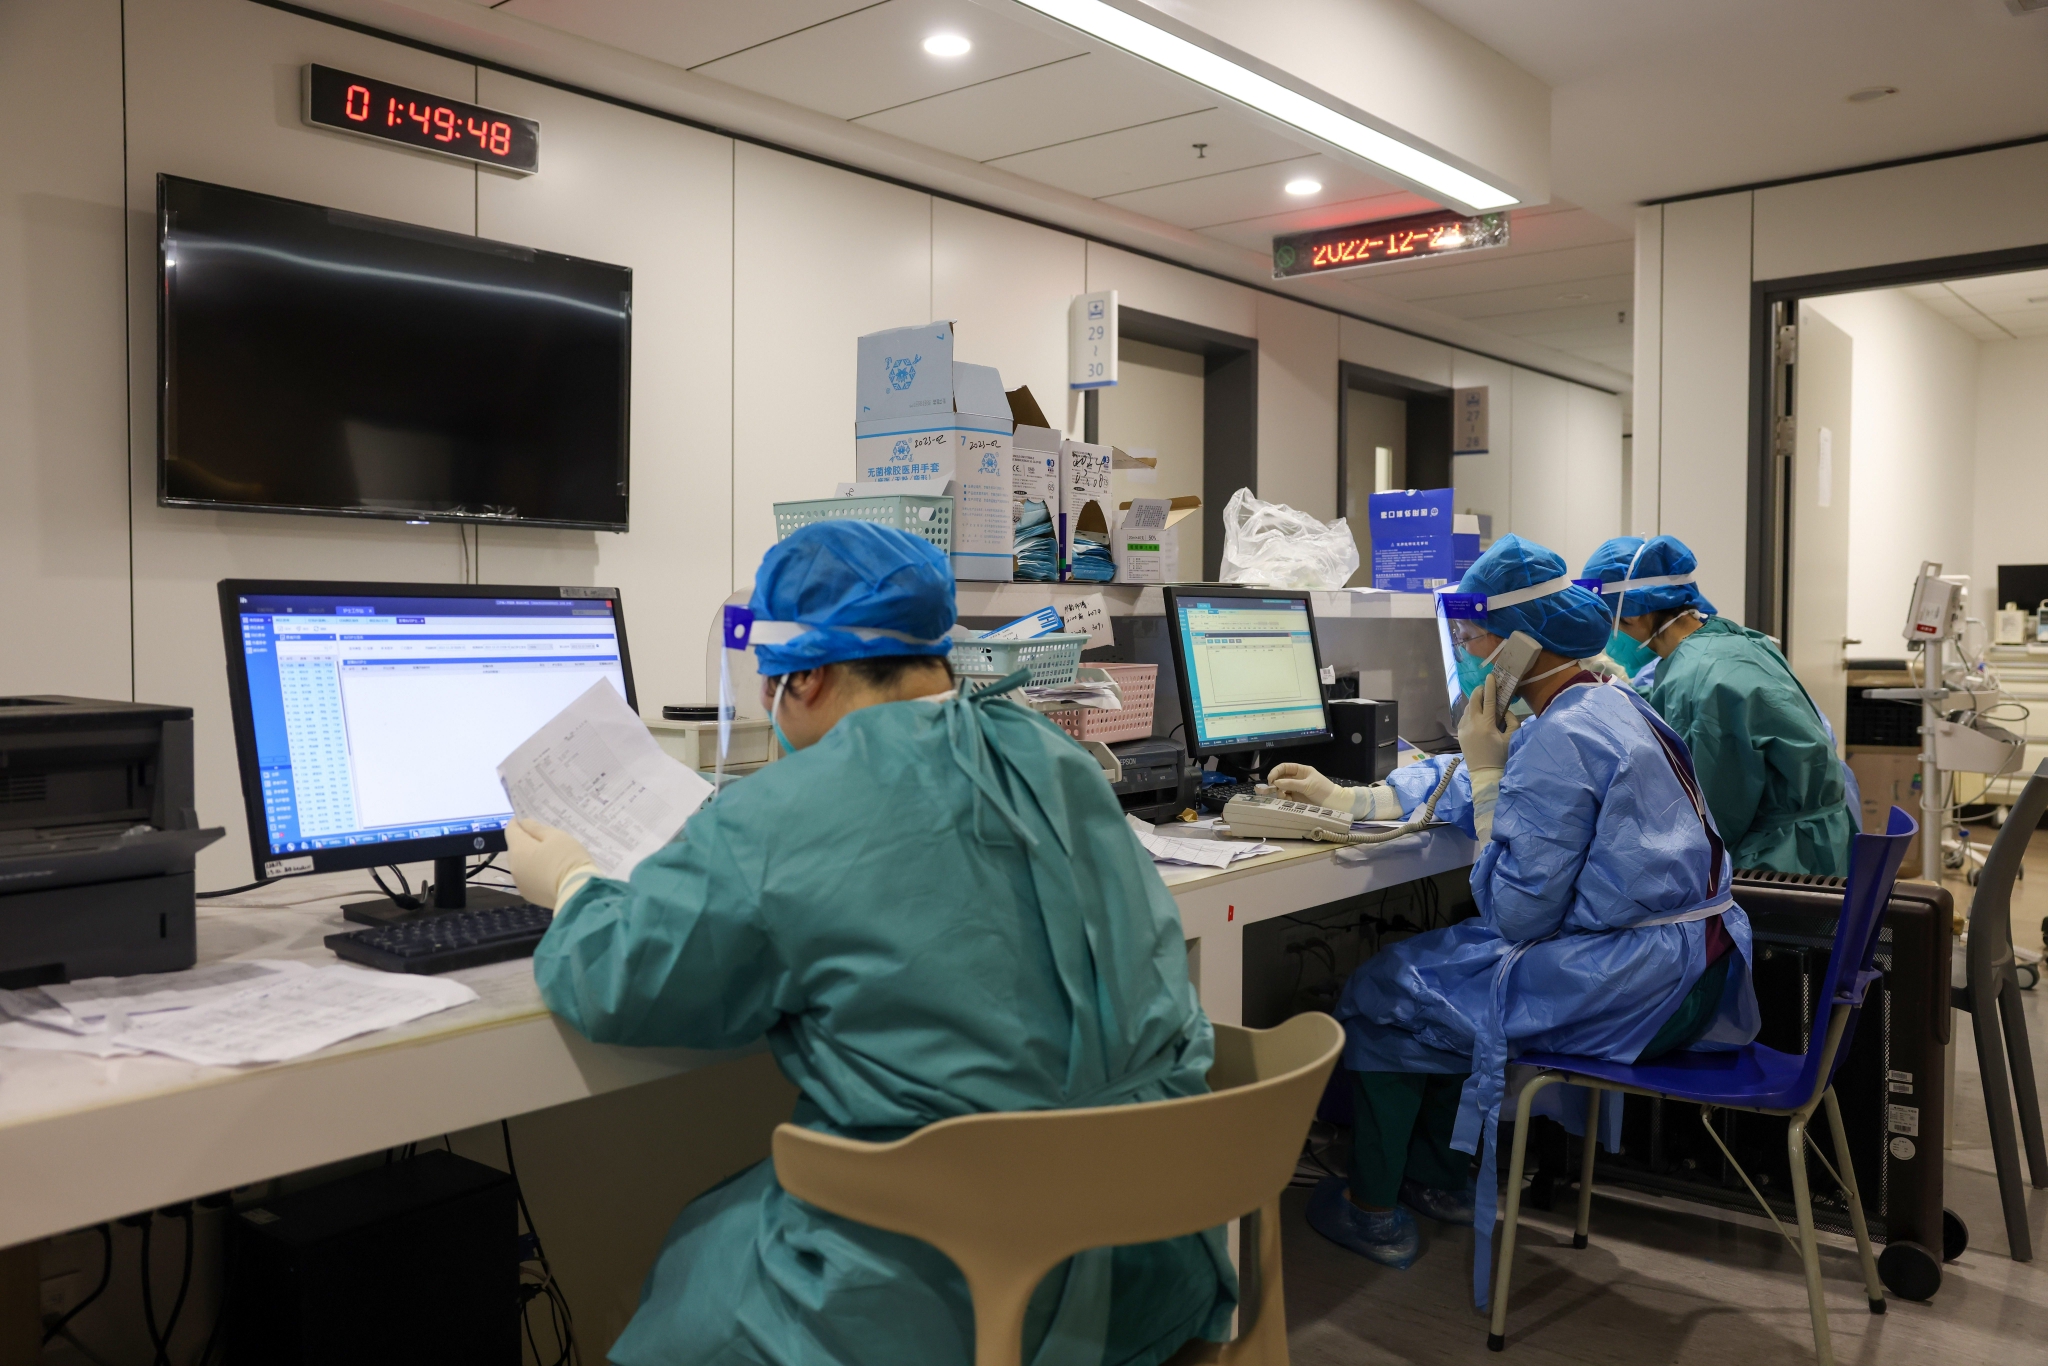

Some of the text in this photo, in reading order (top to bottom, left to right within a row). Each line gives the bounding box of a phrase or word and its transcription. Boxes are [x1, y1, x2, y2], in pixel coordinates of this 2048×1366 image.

[345, 84, 512, 157] 01:49:48
[1088, 325, 1104, 341] 29
[1088, 362, 1104, 377] 30
[1466, 410, 1480, 422] 27
[960, 435, 967, 446] 7
[867, 462, 940, 478] 无菌橡胶医用手套
[1119, 757, 1137, 766] EPSON
